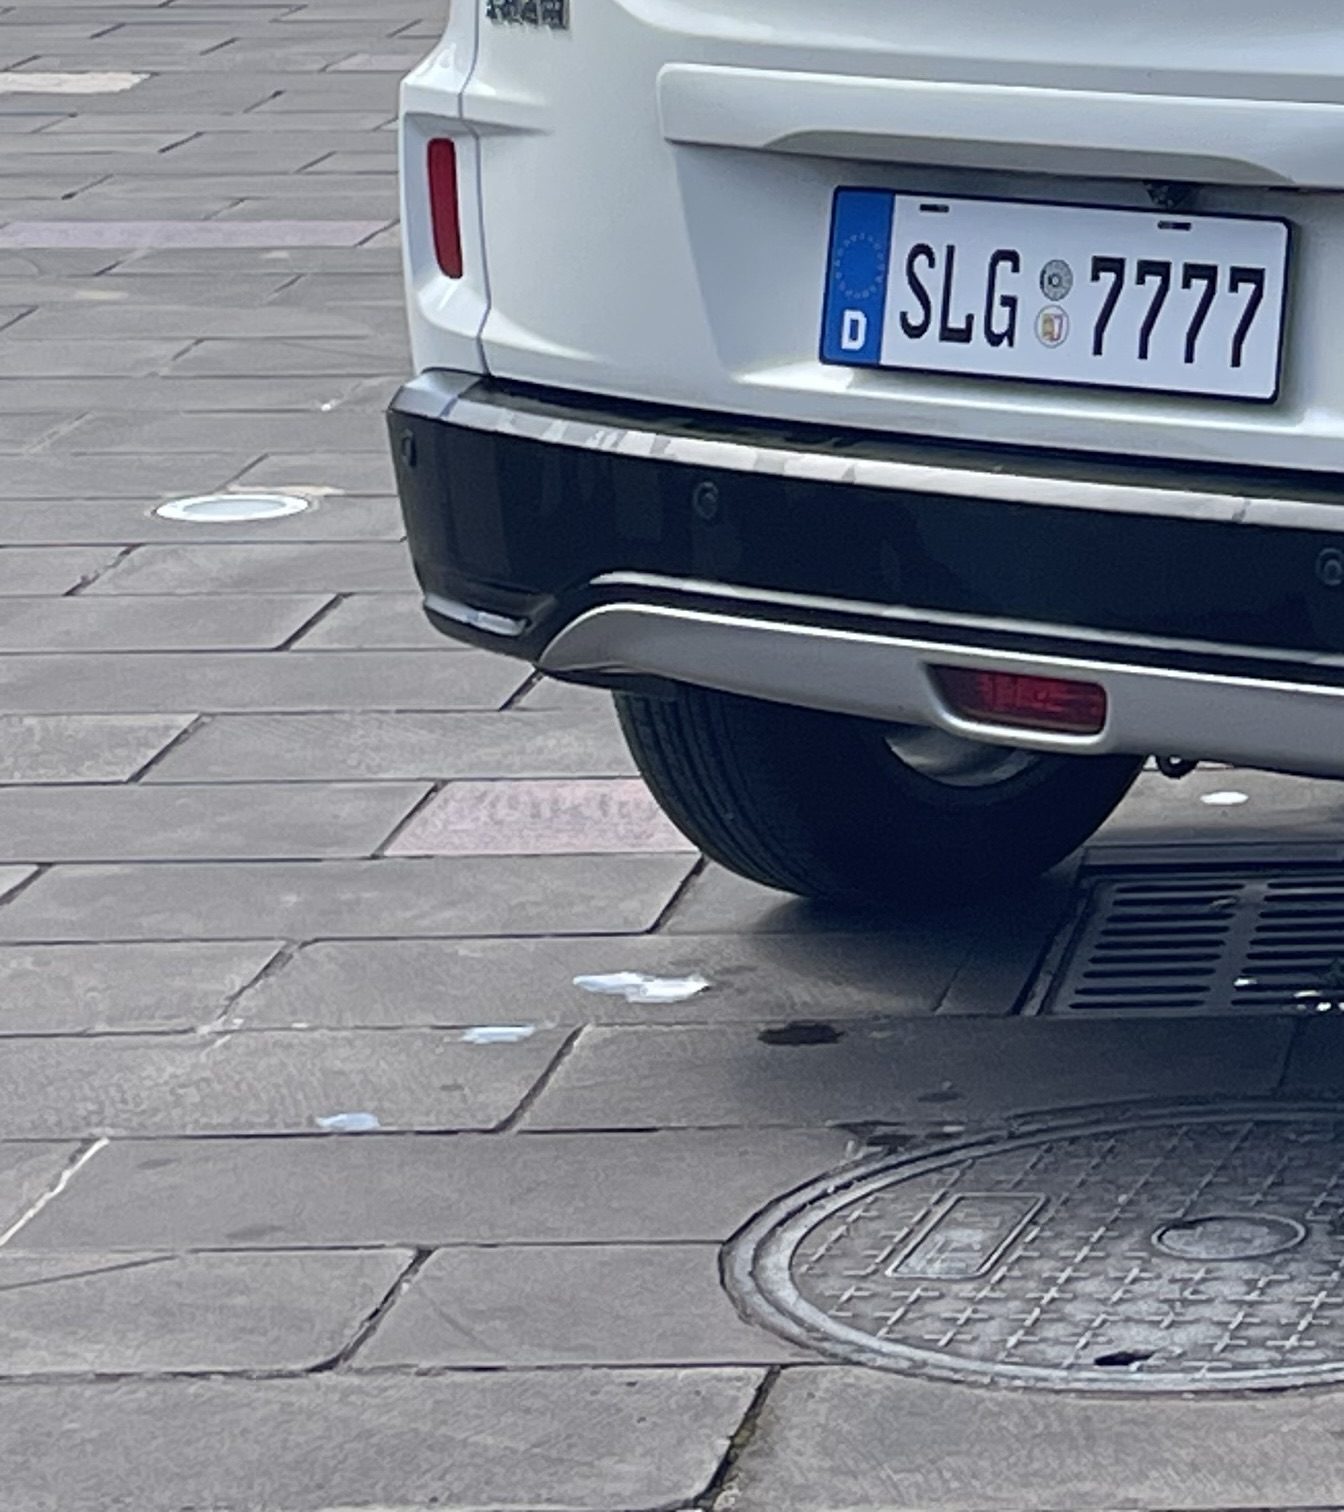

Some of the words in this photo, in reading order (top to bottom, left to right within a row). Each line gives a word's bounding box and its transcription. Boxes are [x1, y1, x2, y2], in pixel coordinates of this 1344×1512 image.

[840, 309, 868, 352] D
[899, 242, 1021, 348] SLG
[1090, 254, 1266, 368] 7777
